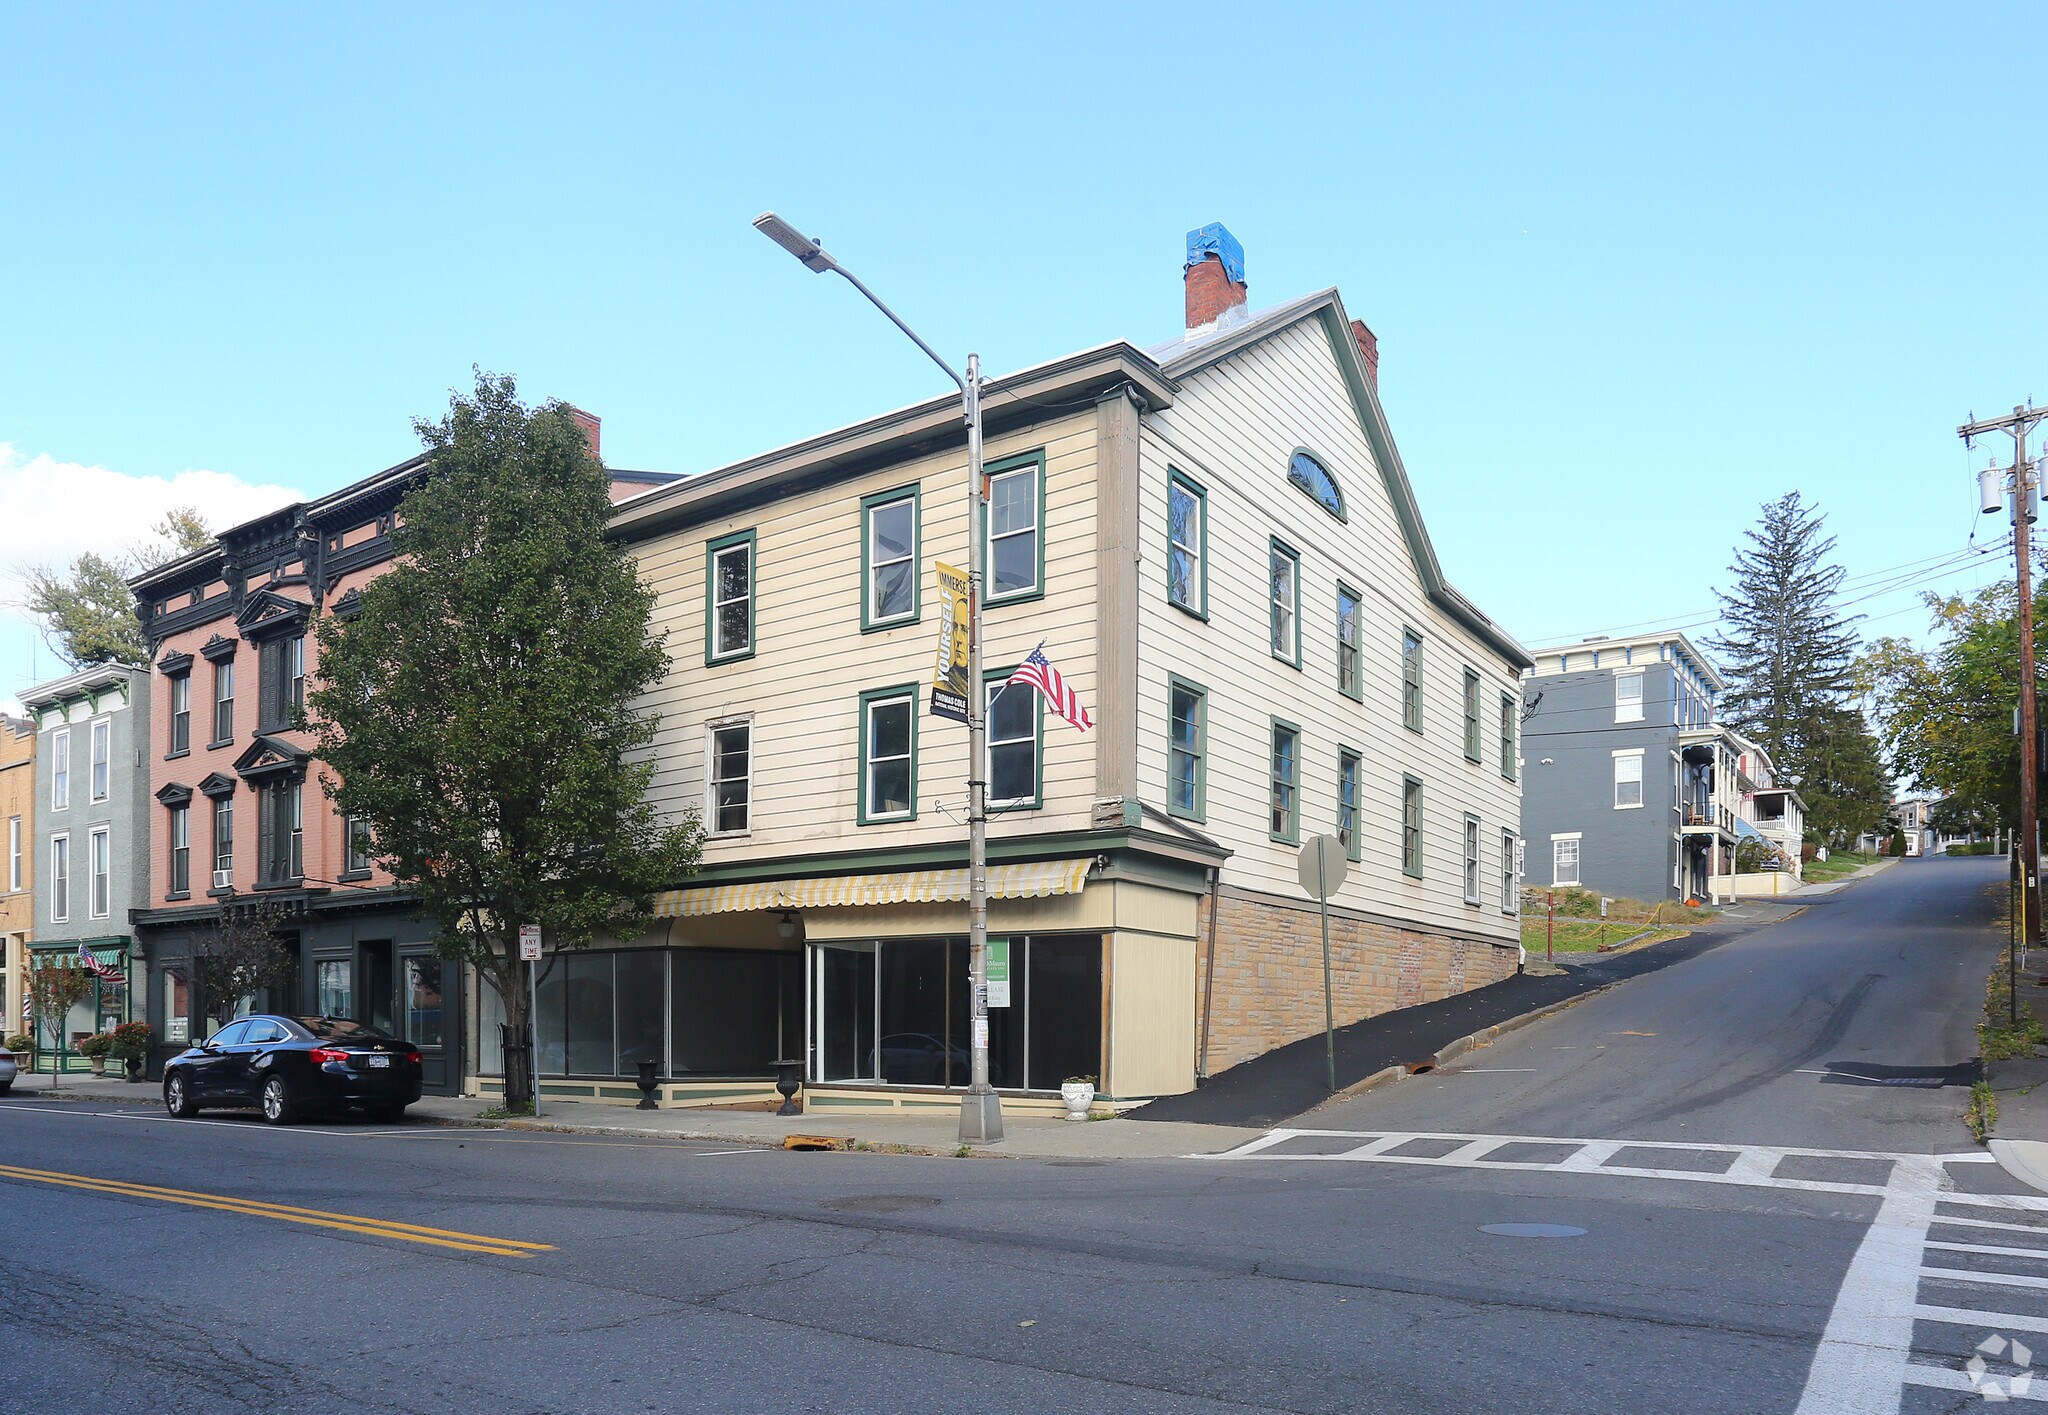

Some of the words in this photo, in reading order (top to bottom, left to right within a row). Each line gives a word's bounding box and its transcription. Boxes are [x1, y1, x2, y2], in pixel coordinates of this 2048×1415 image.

[939, 572, 966, 595] IMMERSE
[937, 587, 952, 682] YOURSELF
[935, 692, 954, 705] THOMAS
[954, 698, 966, 709] COLE
